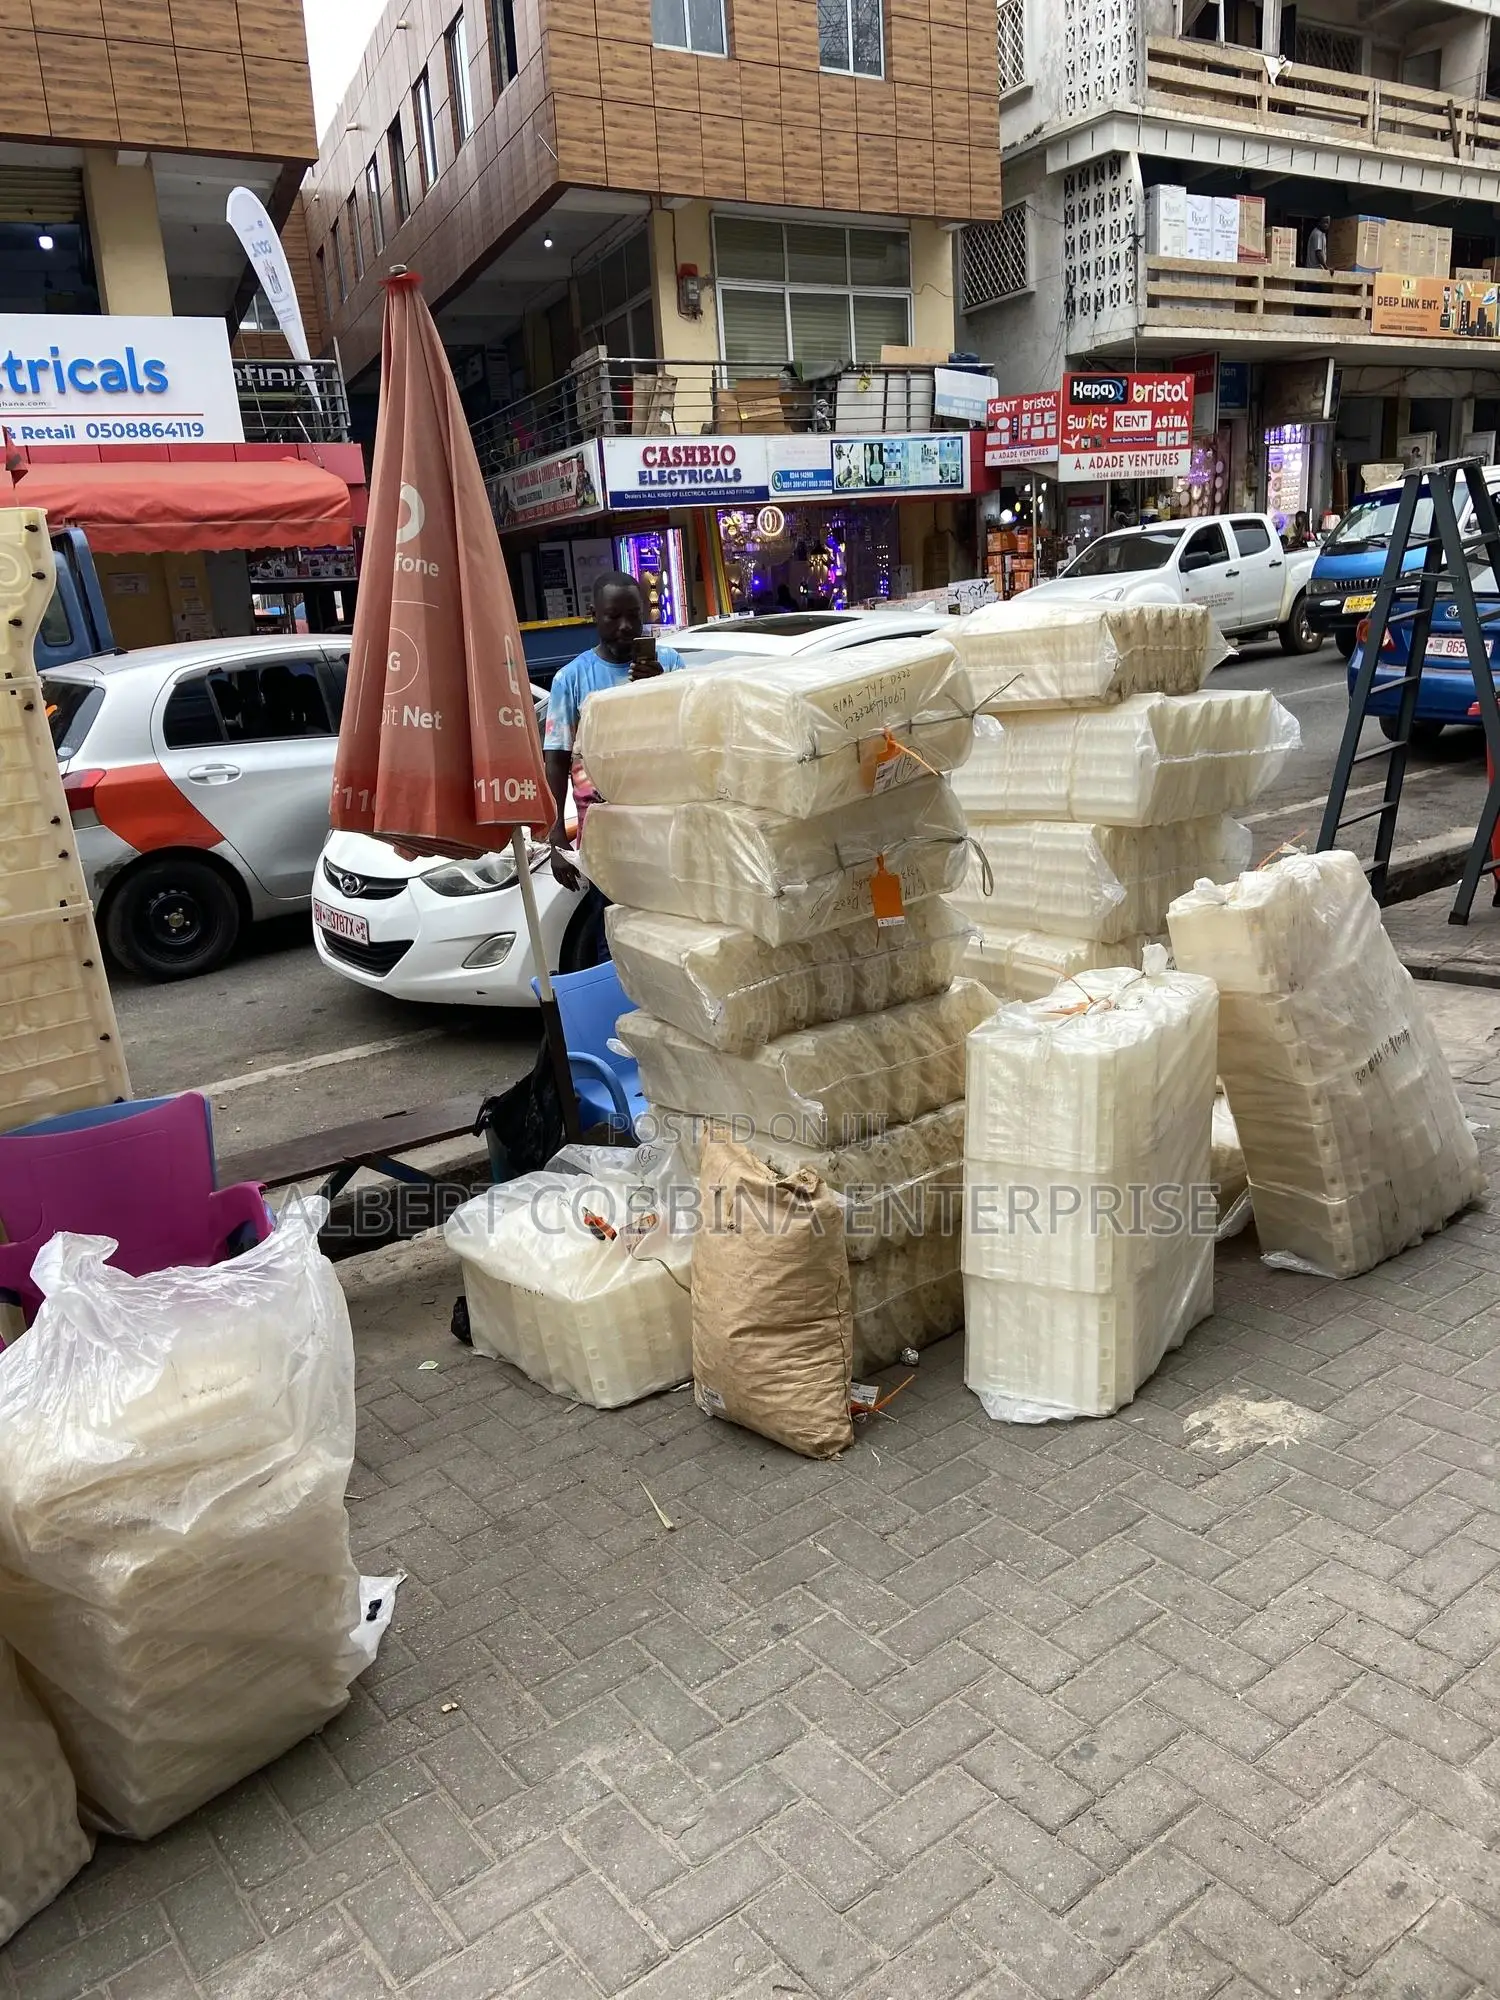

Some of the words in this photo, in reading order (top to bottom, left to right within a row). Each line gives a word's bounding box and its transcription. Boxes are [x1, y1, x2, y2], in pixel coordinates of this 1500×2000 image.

[1377, 296, 1399, 308] DEEP
[1401, 298, 1419, 309] LINK
[1422, 300, 1439, 310] ENT.
[0, 346, 168, 394] tricals
[1073, 381, 1115, 399] Kepas
[1132, 380, 1188, 402] bristol
[988, 400, 1017, 414] KENT
[1023, 395, 1056, 410] bristol
[21, 424, 76, 439] Retail
[86, 422, 204, 438] 0508864119
[1115, 415, 1148, 428] KENT
[642, 444, 736, 467] CASHBIO
[998, 450, 1017, 459] ADADE
[1019, 448, 1049, 457] VENTURES
[1074, 458, 1084, 470] A.
[1089, 455, 1124, 469] ADADE
[1128, 452, 1179, 467] VENTURES
[638, 468, 742, 486] ELECTRICALS
[402, 705, 442, 730] Net
[474, 778, 537, 803] 110#
